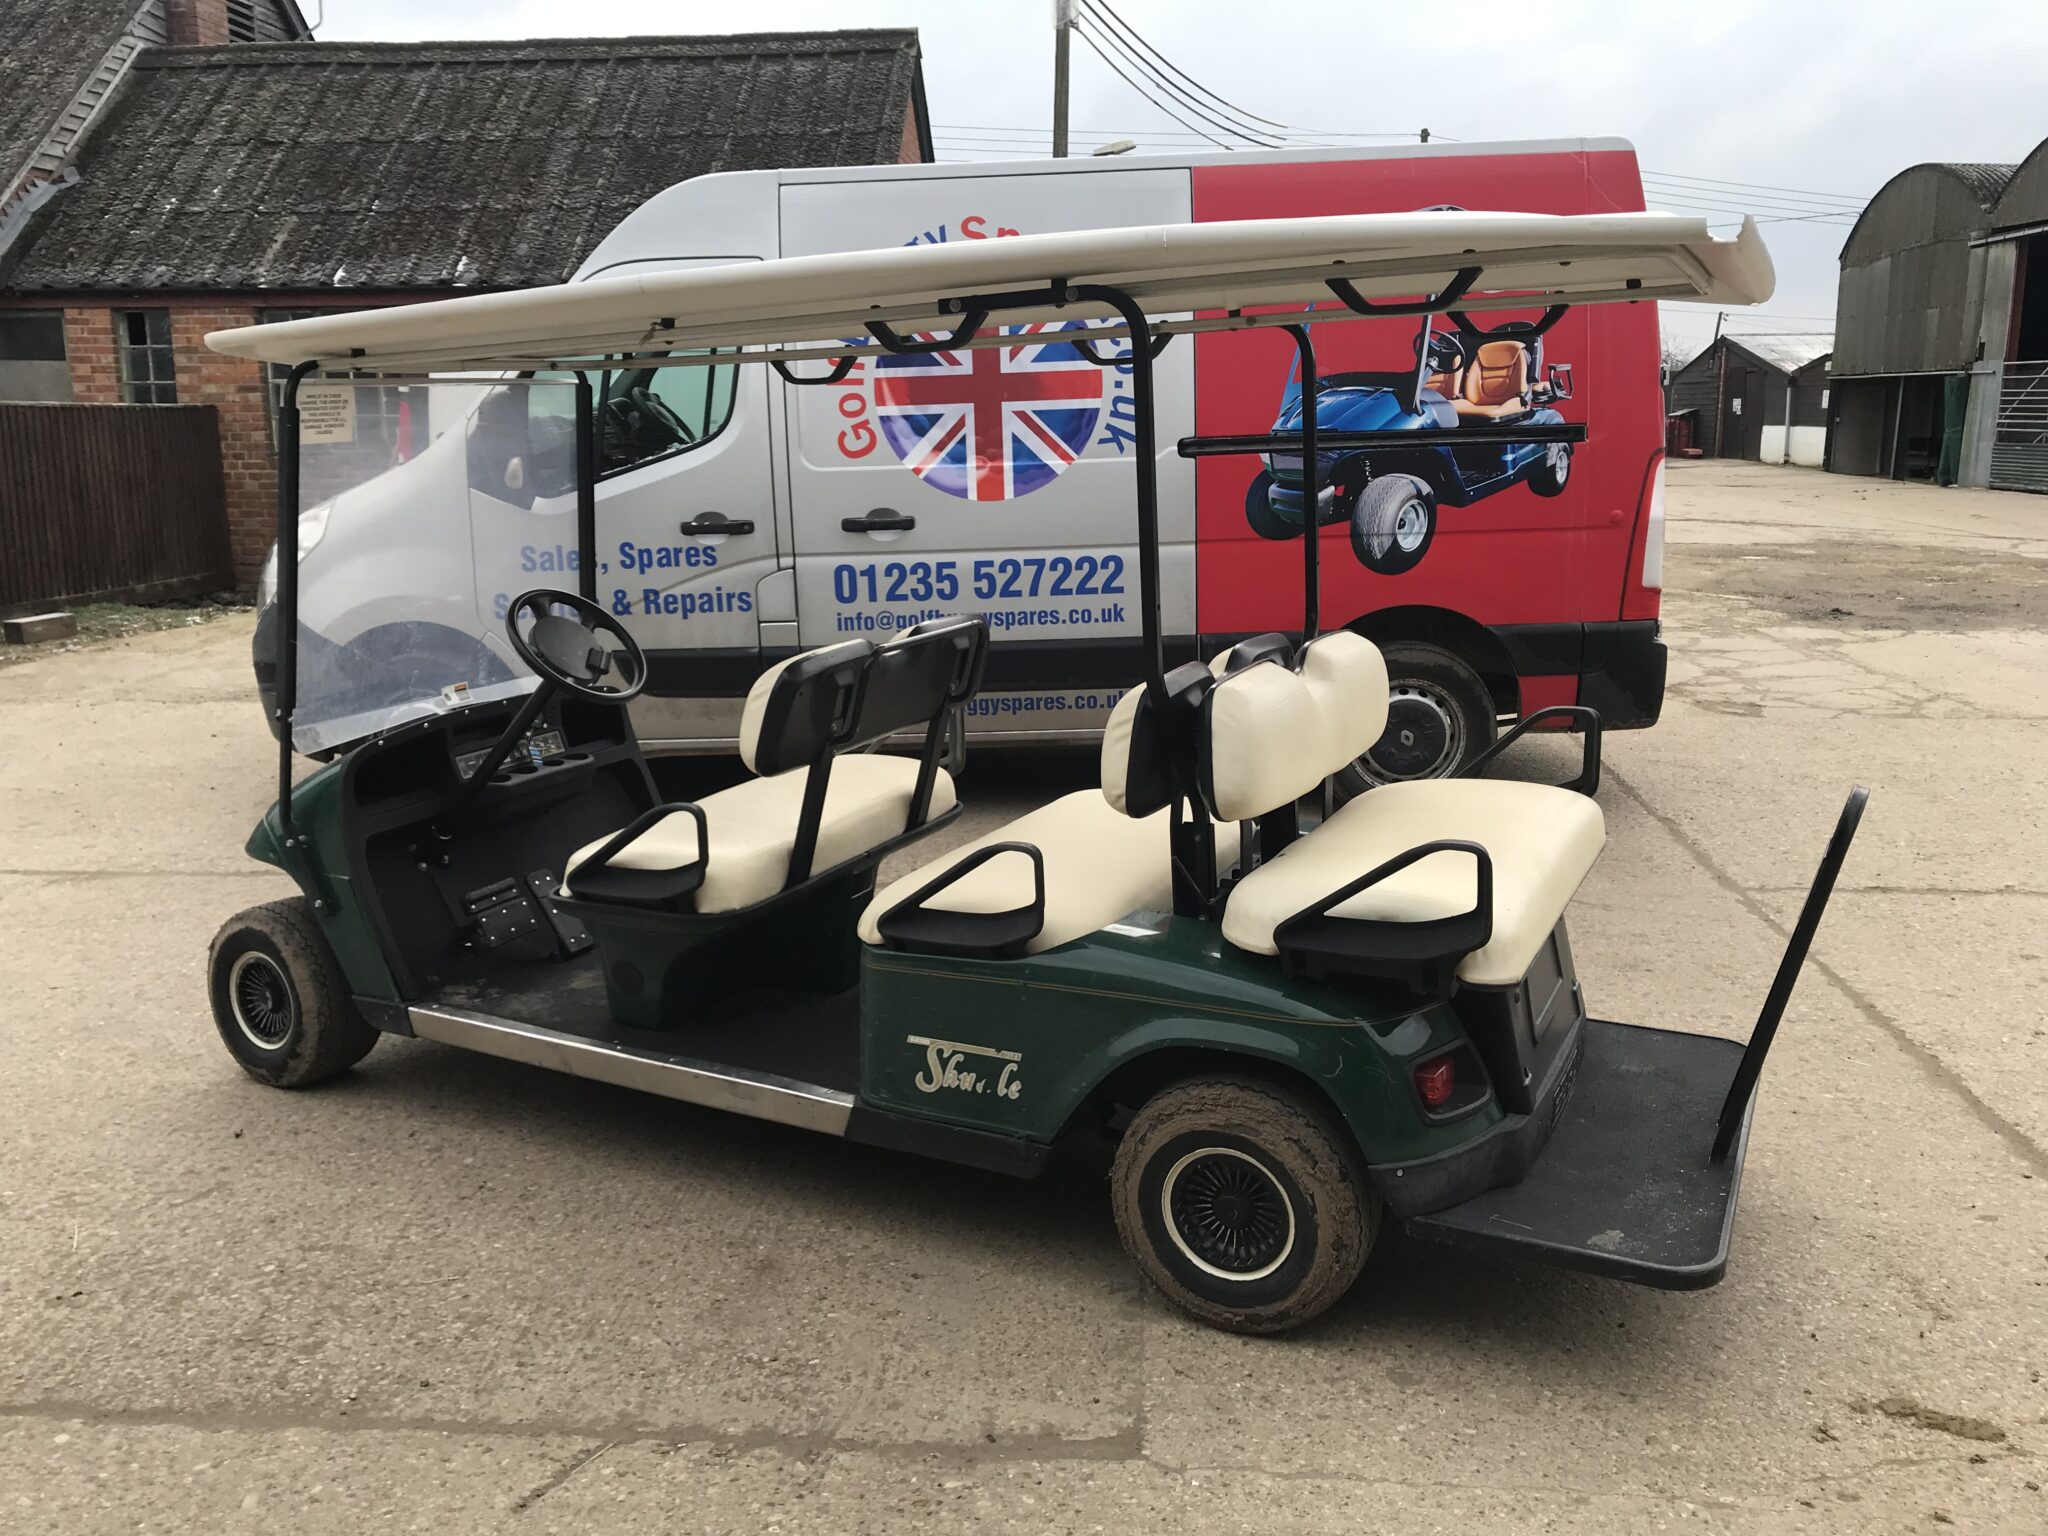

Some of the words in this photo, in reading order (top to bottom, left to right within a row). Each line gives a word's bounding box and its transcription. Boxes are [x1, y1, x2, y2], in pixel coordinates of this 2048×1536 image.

[520, 543, 608, 575] Sale,
[618, 540, 718, 575] Spares
[833, 560, 959, 604] 01235
[973, 554, 1125, 600] 527222
[611, 588, 633, 616] &
[643, 585, 753, 619] Repairs
